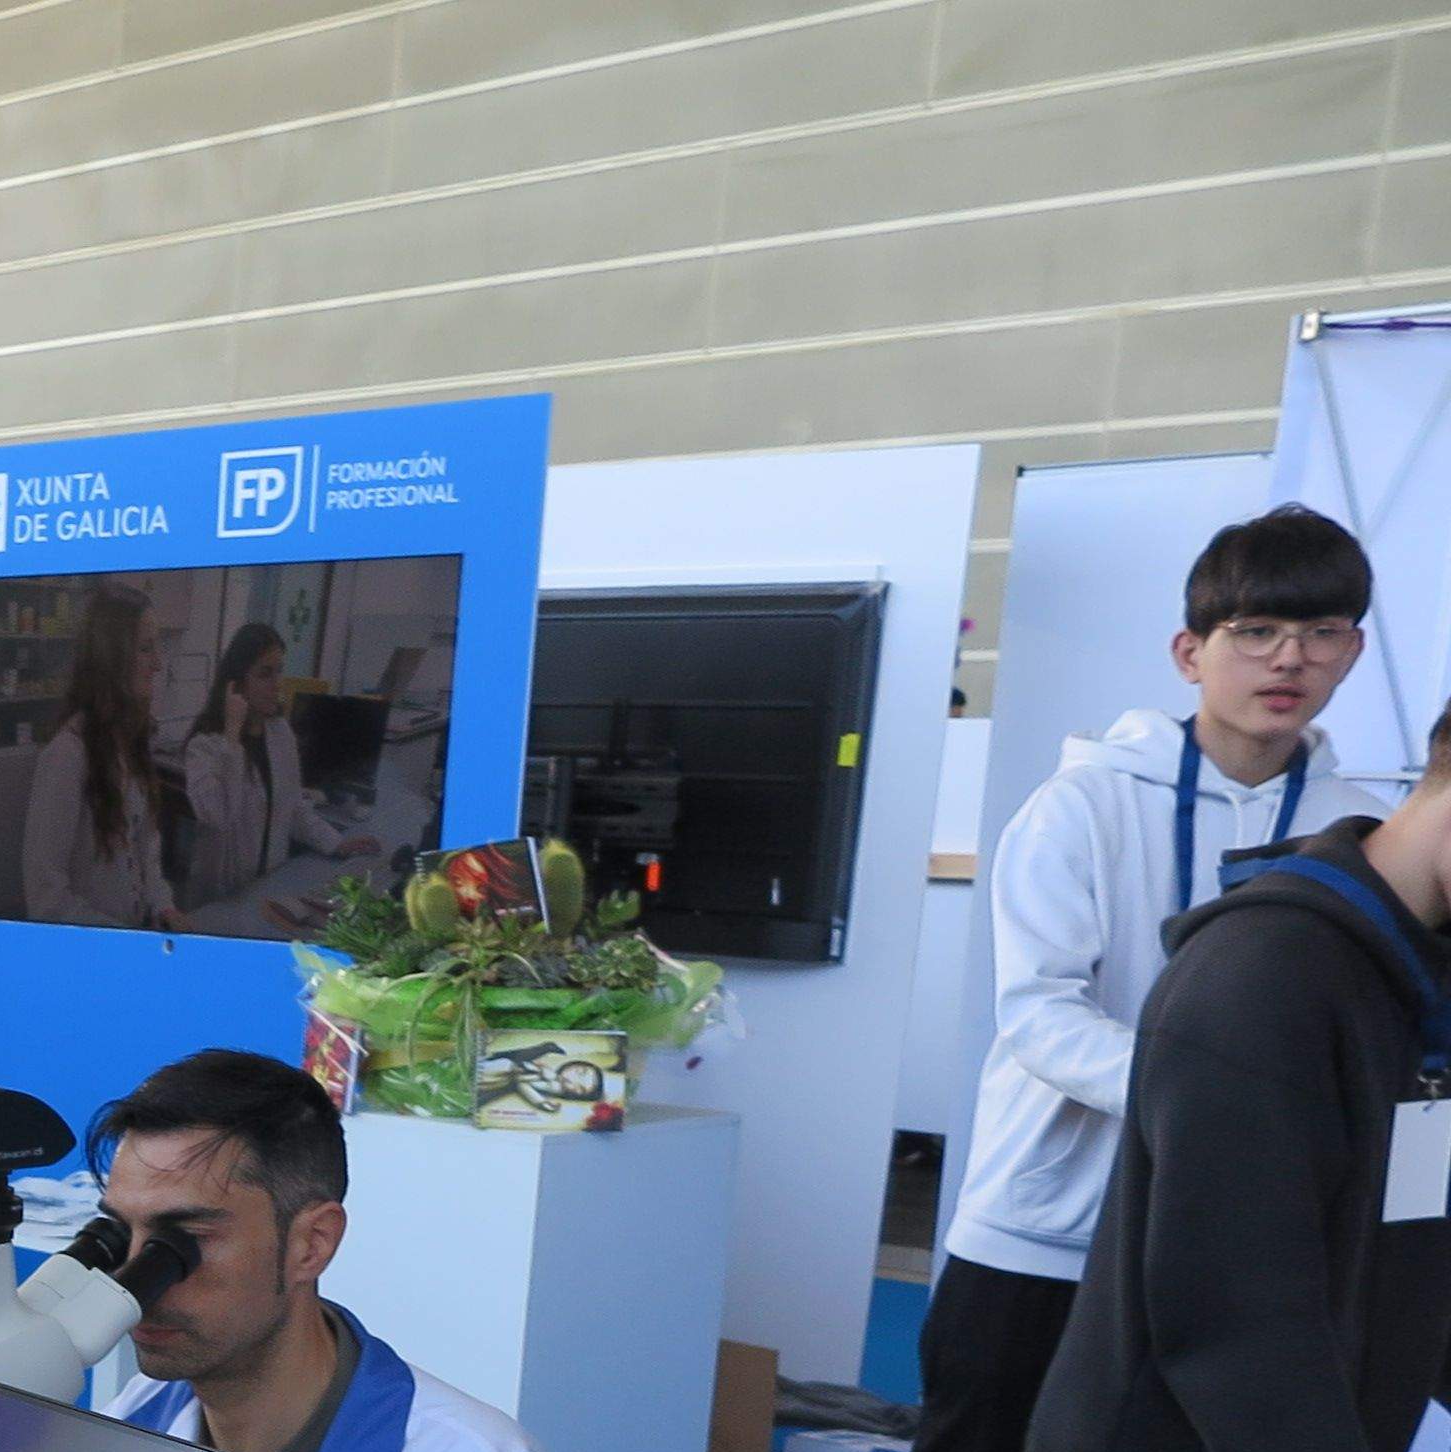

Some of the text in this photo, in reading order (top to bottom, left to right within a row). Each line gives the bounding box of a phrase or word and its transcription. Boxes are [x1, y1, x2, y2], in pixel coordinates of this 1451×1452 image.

[326, 450, 446, 484] FORMACIÓN
[14, 472, 111, 507] XUNTA
[232, 467, 287, 518] FP
[324, 482, 459, 511] PROFESIONAL
[13, 505, 169, 544] DE GALICIA
